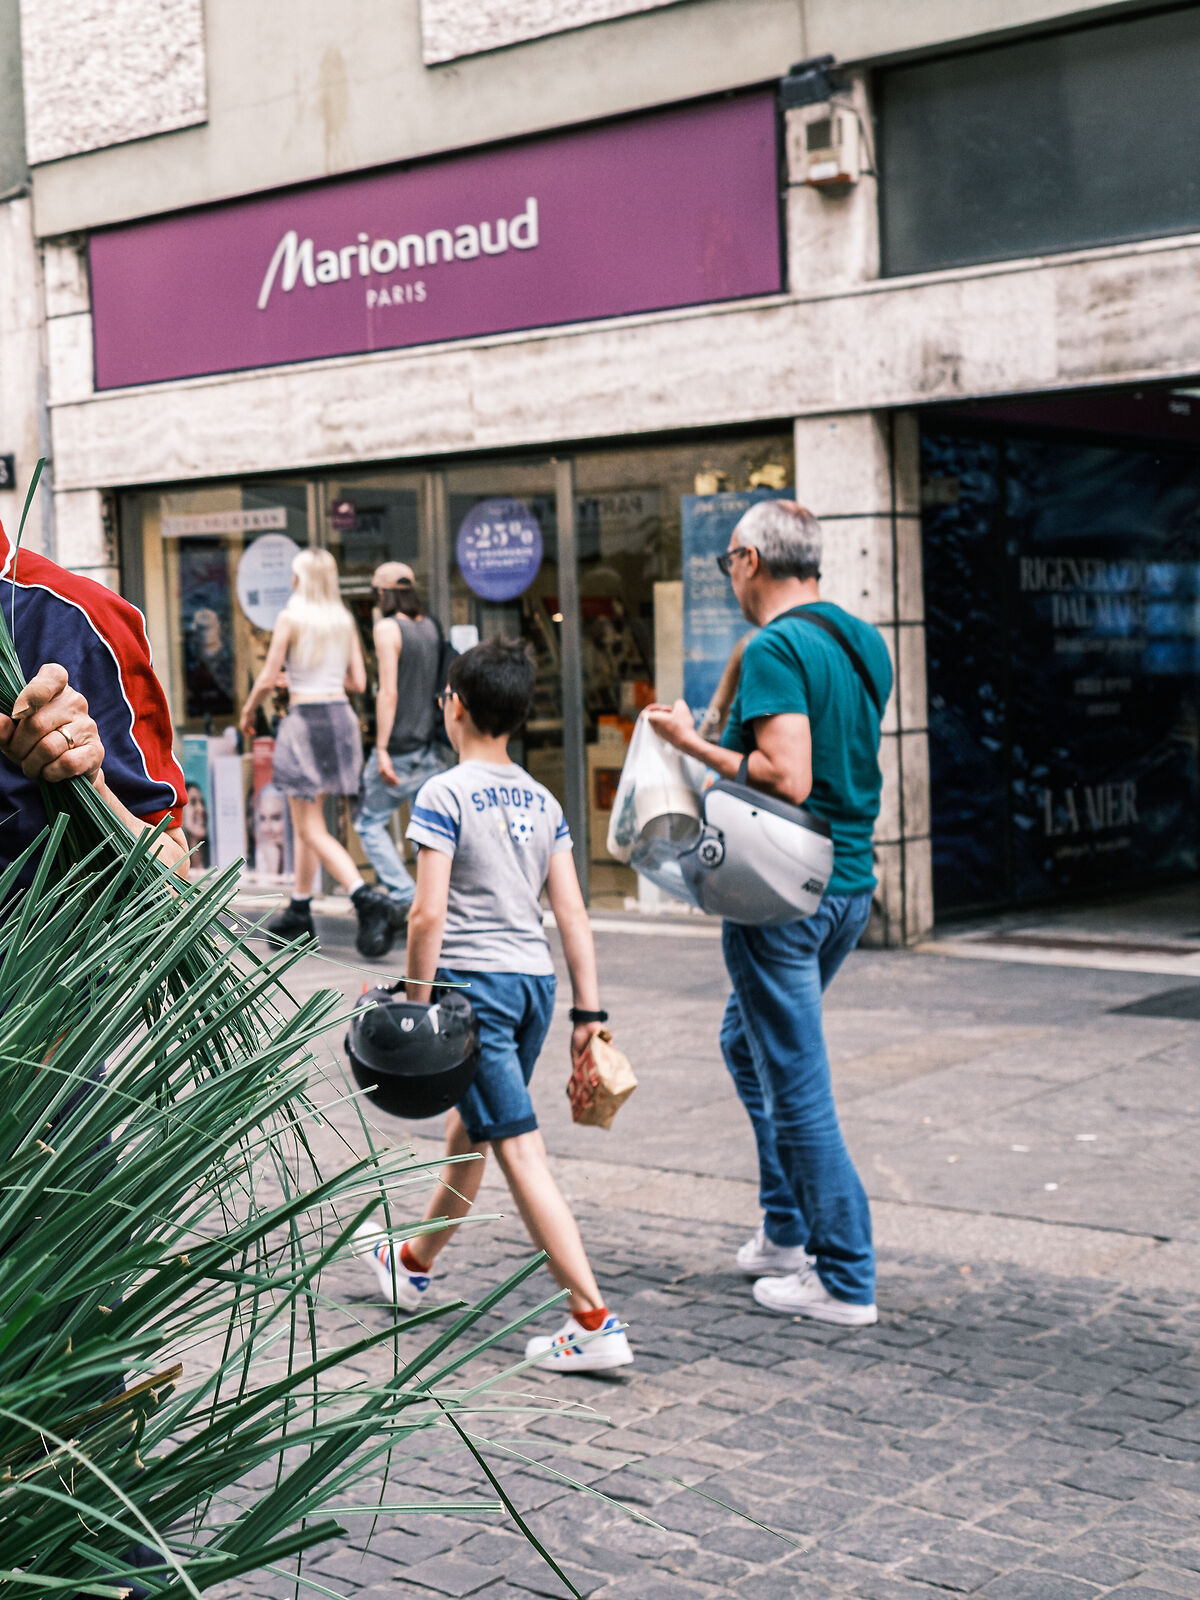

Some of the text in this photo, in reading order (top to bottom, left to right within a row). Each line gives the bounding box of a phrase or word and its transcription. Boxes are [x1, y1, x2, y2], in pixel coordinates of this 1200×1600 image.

[257, 196, 539, 310] Marionnaud
[366, 280, 428, 309] PARIS
[464, 519, 535, 549] -25%
[471, 786, 547, 813] SNOOPY
